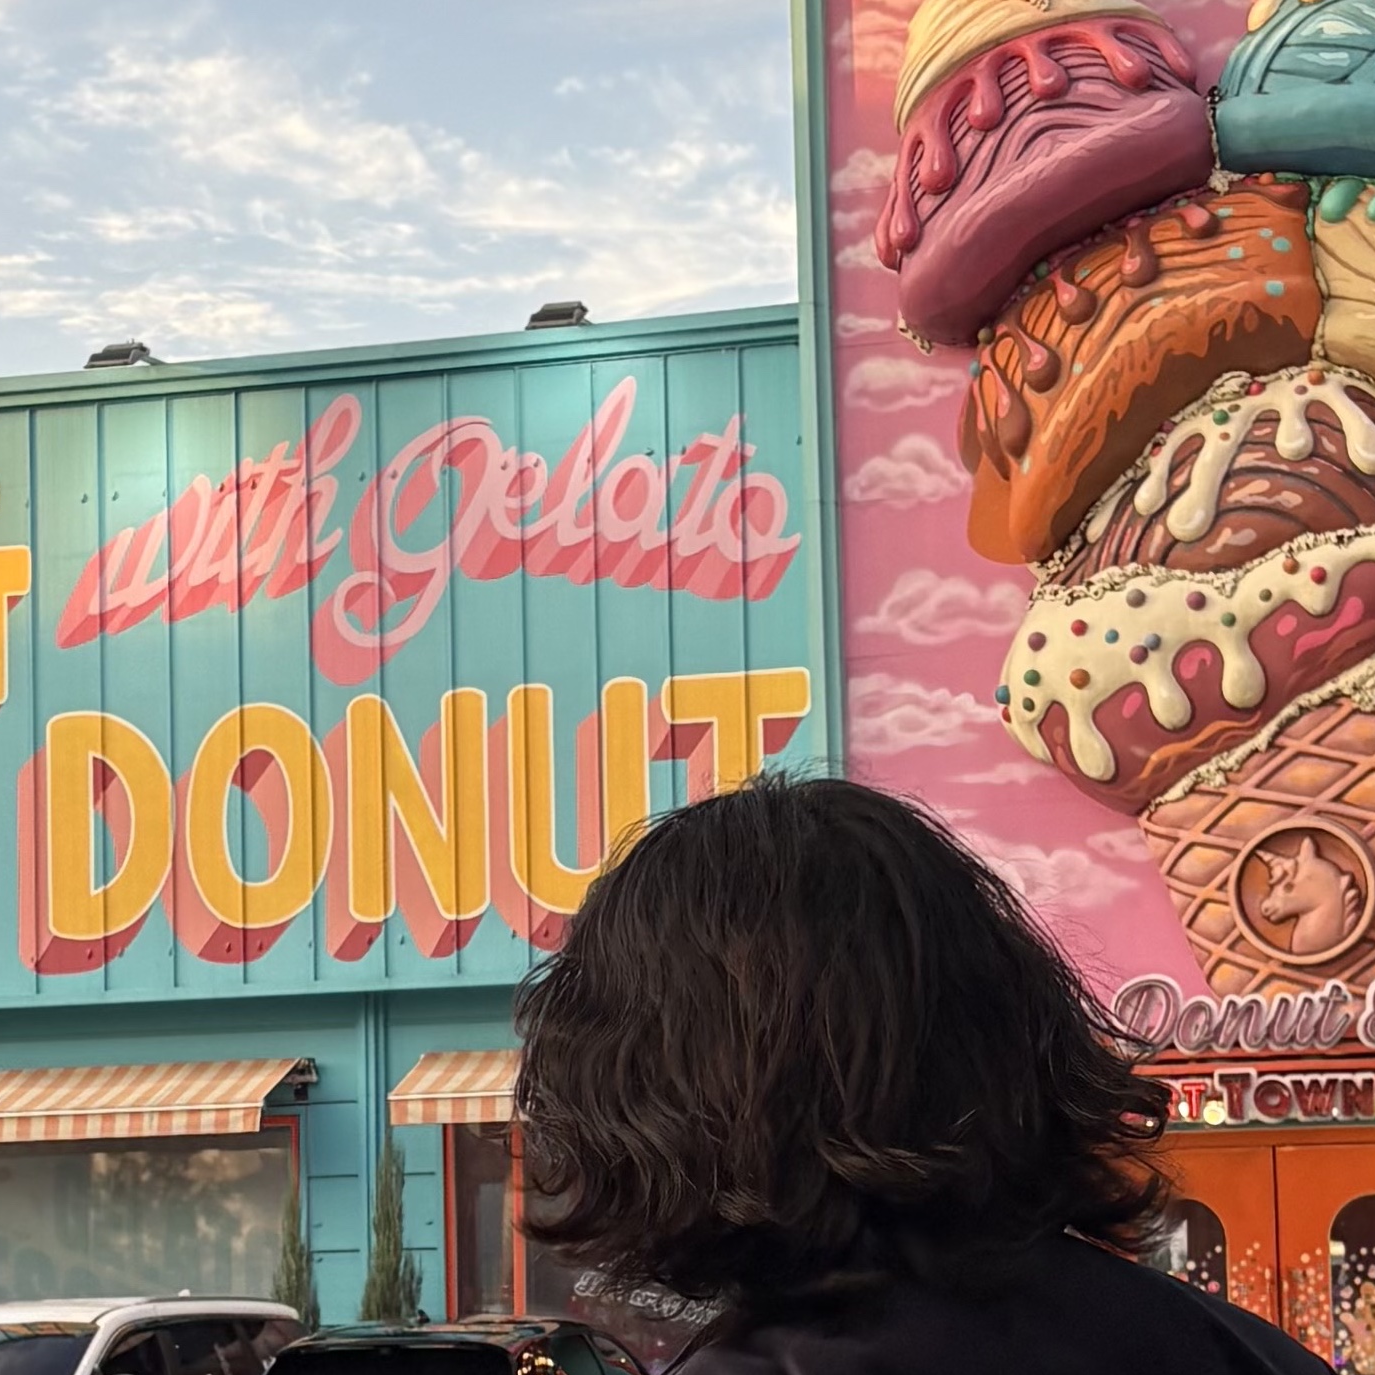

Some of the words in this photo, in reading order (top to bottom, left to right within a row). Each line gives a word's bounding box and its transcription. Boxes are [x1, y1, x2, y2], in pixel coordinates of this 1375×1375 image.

[56, 394, 363, 649] with
[17, 666, 810, 975] DONUT
[1115, 974, 1353, 1056] Donut
